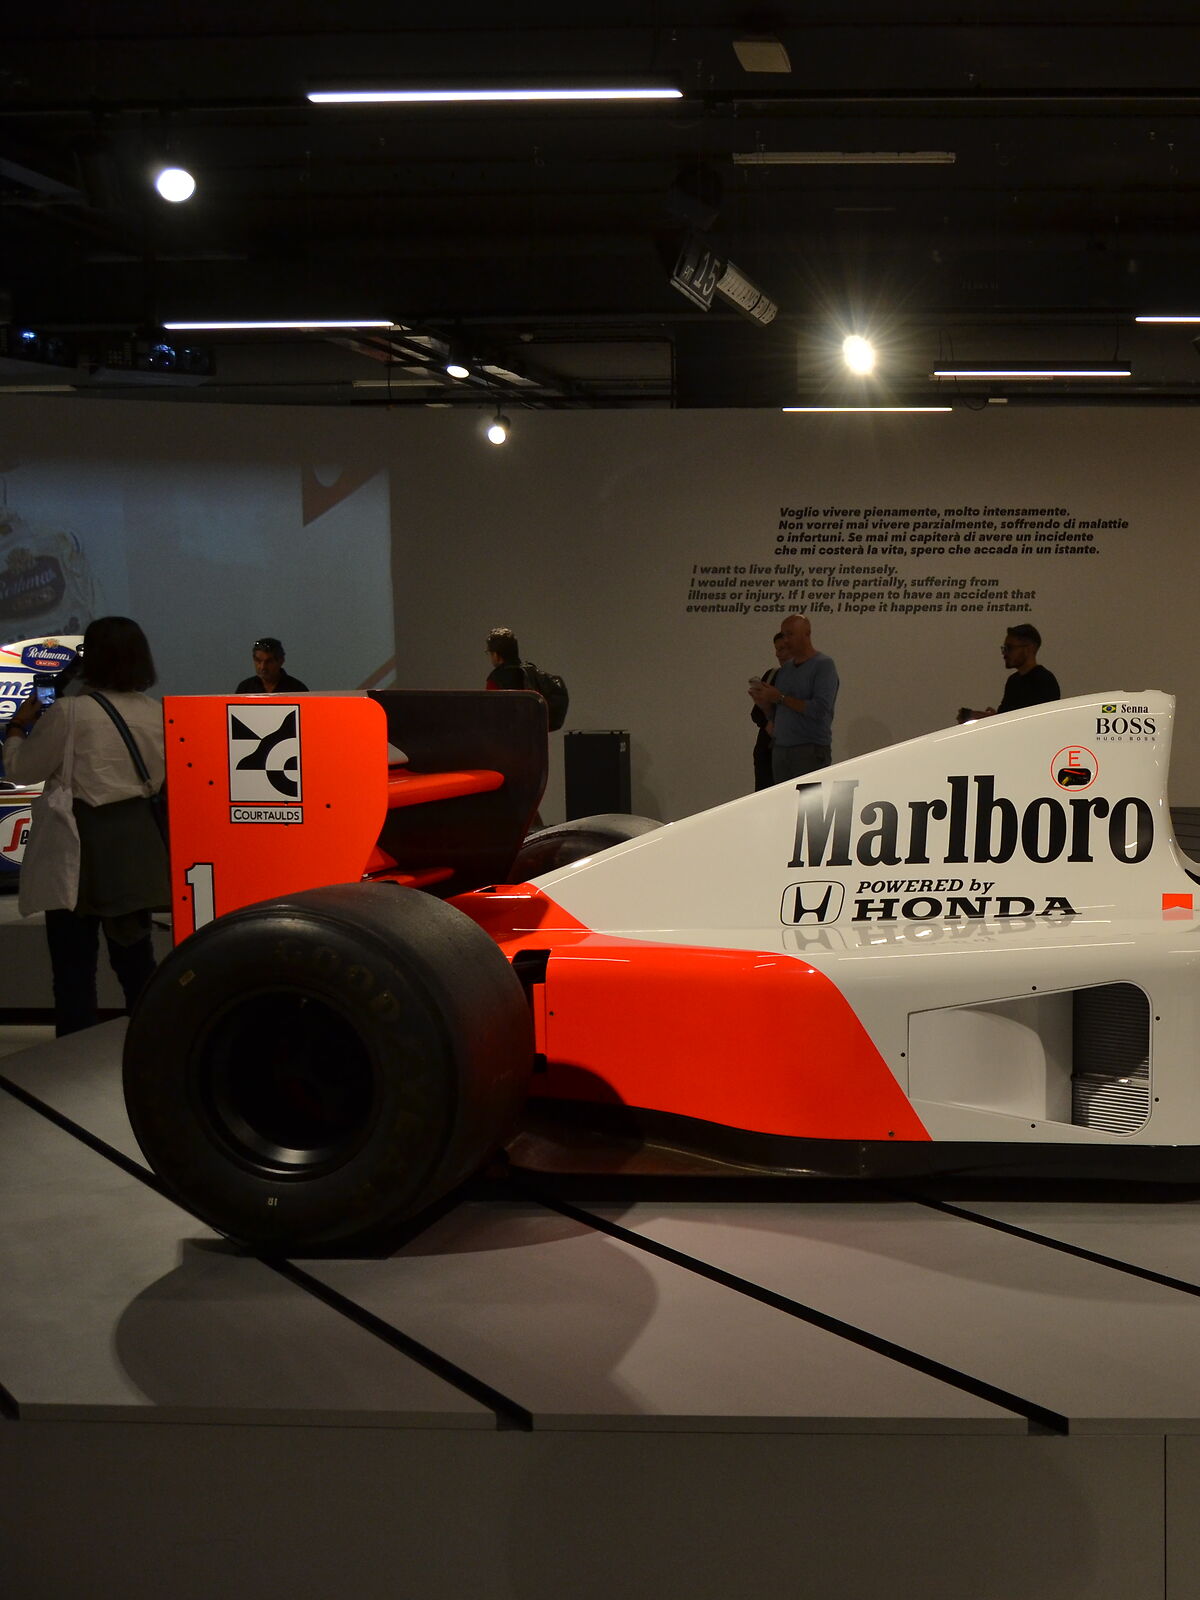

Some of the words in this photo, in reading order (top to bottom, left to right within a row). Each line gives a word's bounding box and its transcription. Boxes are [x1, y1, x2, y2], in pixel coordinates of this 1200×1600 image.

[780, 507, 819, 519] Voglio
[822, 507, 861, 516] vivere
[863, 507, 940, 519] pienamente,
[944, 507, 980, 516] molto
[982, 507, 1069, 516] intensamente.
[778, 521, 803, 530] Non
[806, 521, 843, 530] vorrei
[846, 521, 868, 530] mai
[871, 521, 910, 530] vivere
[912, 521, 997, 533] parzialmente,
[1000, 520, 1060, 530] soffrendo
[1063, 520, 1075, 530] di
[1078, 520, 1128, 529] malattie
[786, 533, 844, 542] infortuni.
[847, 533, 862, 542] Se
[865, 533, 888, 542] mai
[890, 533, 906, 542] mi
[909, 533, 960, 545] capiterà
[963, 533, 976, 542] di
[978, 534, 1012, 542] avere
[1015, 534, 1031, 542] un
[1034, 532, 1093, 542] incidente
[774, 546, 797, 555] che
[800, 546, 816, 555] mi
[818, 546, 864, 555] costerà
[866, 546, 878, 555] la
[880, 546, 907, 557] vita,
[910, 547, 945, 558] spero
[948, 546, 970, 555] che
[973, 545, 1018, 555] accada
[1021, 545, 1032, 555] in
[1036, 547, 1051, 555] un
[1054, 545, 1099, 554] istante.
[692, 565, 697, 574] I
[700, 565, 731, 574] want
[733, 565, 746, 574] to
[749, 565, 772, 574] live
[774, 565, 804, 577] fully,
[808, 567, 836, 577] very
[838, 565, 898, 577] intensely.
[690, 578, 694, 587] I
[698, 578, 737, 587] would
[777, 578, 809, 587] want
[811, 578, 824, 587] to
[826, 578, 850, 587] live
[852, 578, 907, 590] partially,
[910, 578, 967, 590] suffering
[969, 578, 998, 587] from
[688, 591, 726, 600] illness
[745, 591, 784, 603] injury.
[788, 591, 798, 600] If
[800, 591, 805, 600] I
[807, 592, 836, 600] ever
[838, 591, 884, 603] happen
[887, 590, 900, 600] to
[902, 590, 932, 600] have
[953, 590, 1008, 599] accident
[1010, 590, 1036, 599] that
[686, 604, 751, 616] eventually
[753, 603, 785, 613] costs
[788, 605, 807, 616] my
[810, 603, 833, 614] life,
[837, 603, 841, 613] I
[844, 603, 876, 616] hope
[878, 603, 888, 612] it
[890, 603, 942, 615] happens
[945, 603, 957, 612] in
[986, 603, 1032, 612] instant.
[27, 646, 72, 661] Rothmans
[1121, 704, 1149, 713] Senna
[1096, 717, 1156, 735] BOSS
[1068, 750, 1081, 767] E
[233, 809, 300, 821] COURTAULDS
[787, 774, 1154, 868] Marlboro
[856, 879, 963, 895] POWERED
[968, 878, 995, 896] by
[185, 862, 217, 932] 1
[851, 896, 1082, 922] HONDA
